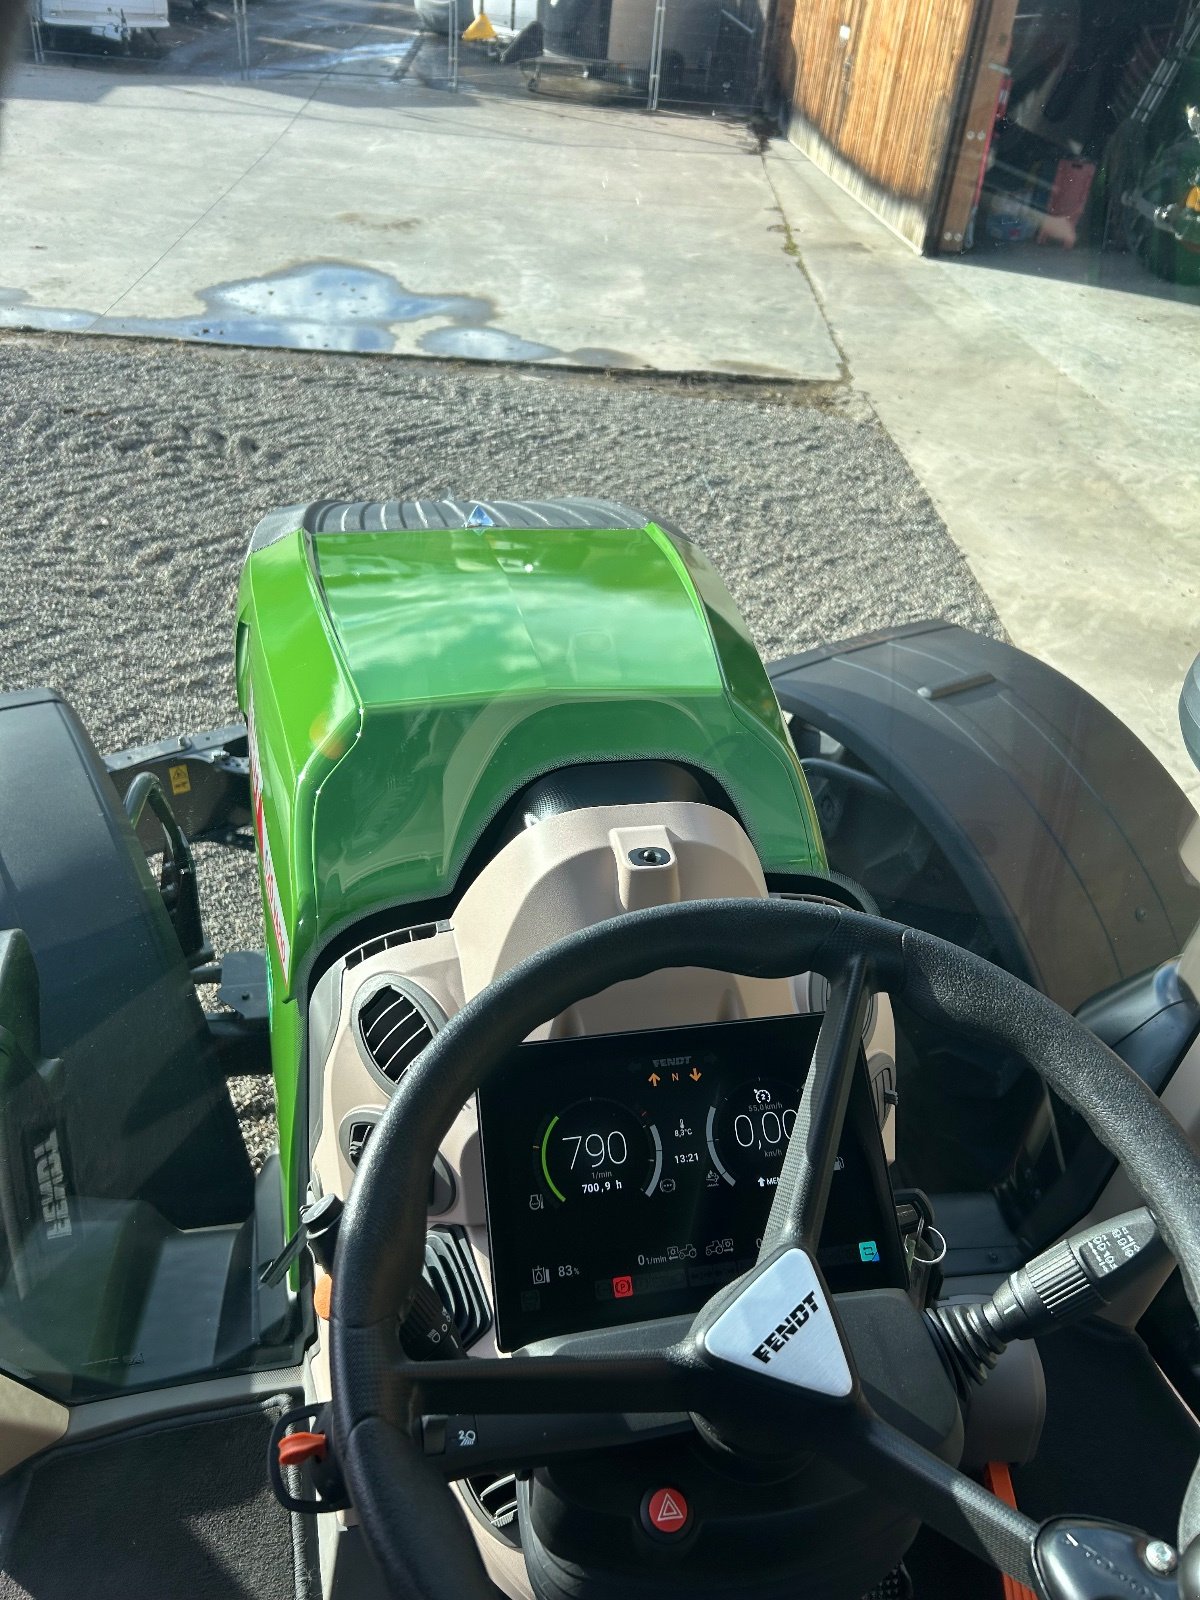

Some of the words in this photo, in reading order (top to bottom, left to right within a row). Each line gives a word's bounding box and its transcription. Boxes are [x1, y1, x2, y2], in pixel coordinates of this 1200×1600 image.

[652, 1055, 692, 1068] FENDT
[671, 1072, 680, 1082] N
[562, 1130, 628, 1170] 790
[764, 1148, 783, 1158] km/h
[674, 1152, 699, 1164] 13:21
[591, 1171, 613, 1180] 1/min
[752, 1290, 819, 1364] FENDT
